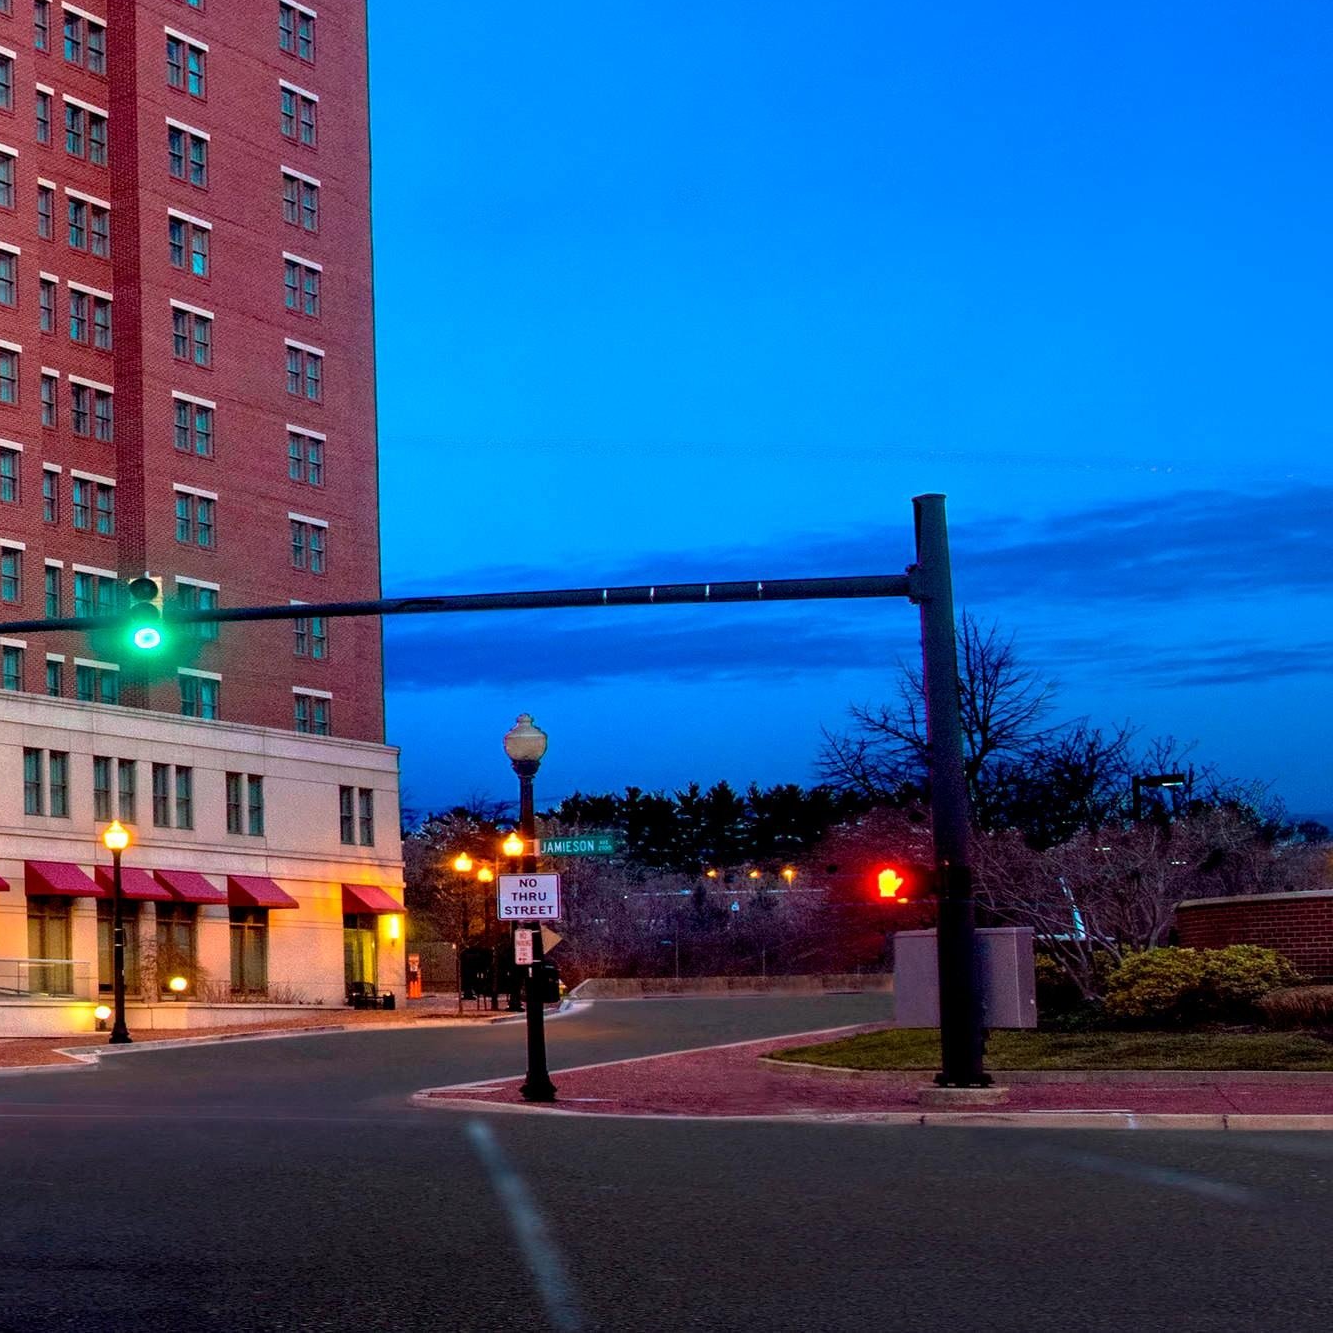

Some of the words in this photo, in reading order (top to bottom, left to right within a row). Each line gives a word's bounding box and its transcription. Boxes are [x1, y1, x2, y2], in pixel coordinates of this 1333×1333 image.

[541, 840, 595, 854] JAMIESON
[519, 879, 537, 887] NO
[511, 892, 547, 901] THRU
[504, 906, 554, 915] STREET
